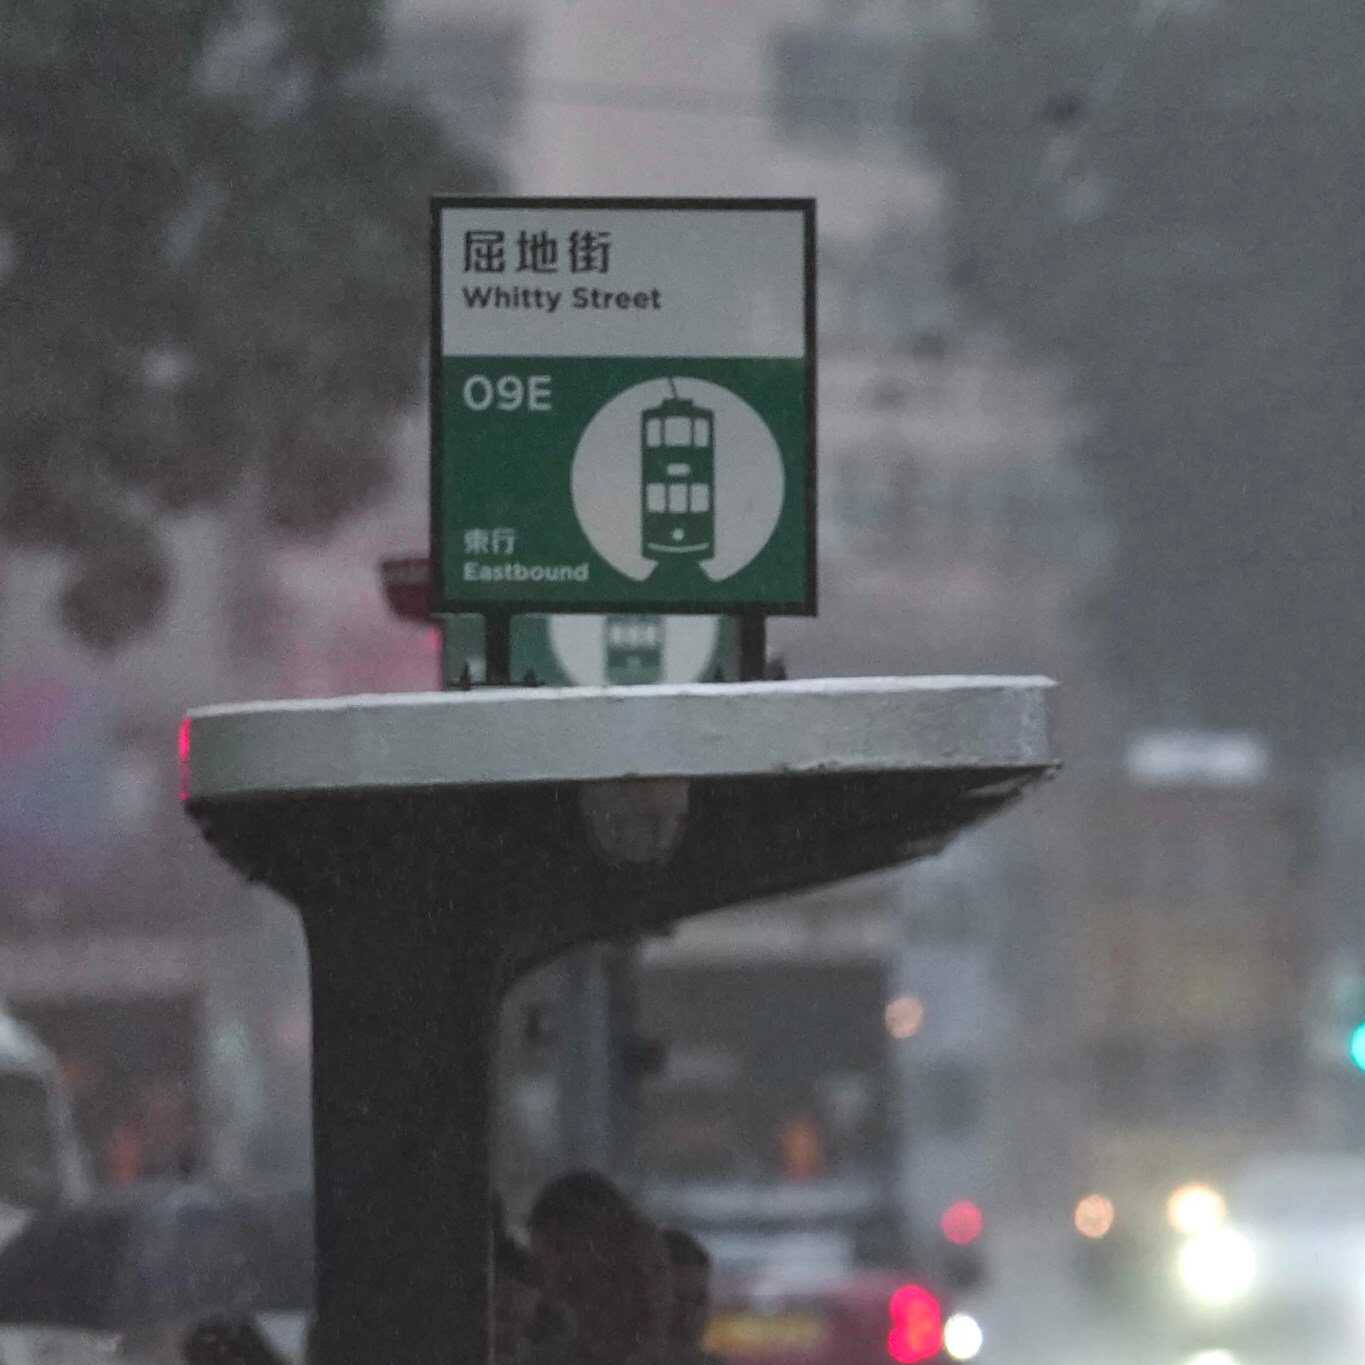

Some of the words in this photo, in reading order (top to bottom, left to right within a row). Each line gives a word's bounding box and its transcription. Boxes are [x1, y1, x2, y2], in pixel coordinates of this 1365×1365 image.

[462, 229, 612, 274] 屈地街
[462, 286, 562, 313] Whitty
[572, 286, 662, 310] Street
[462, 374, 553, 412] 09E
[463, 528, 516, 554] 東行
[463, 561, 590, 582] Eastbound
